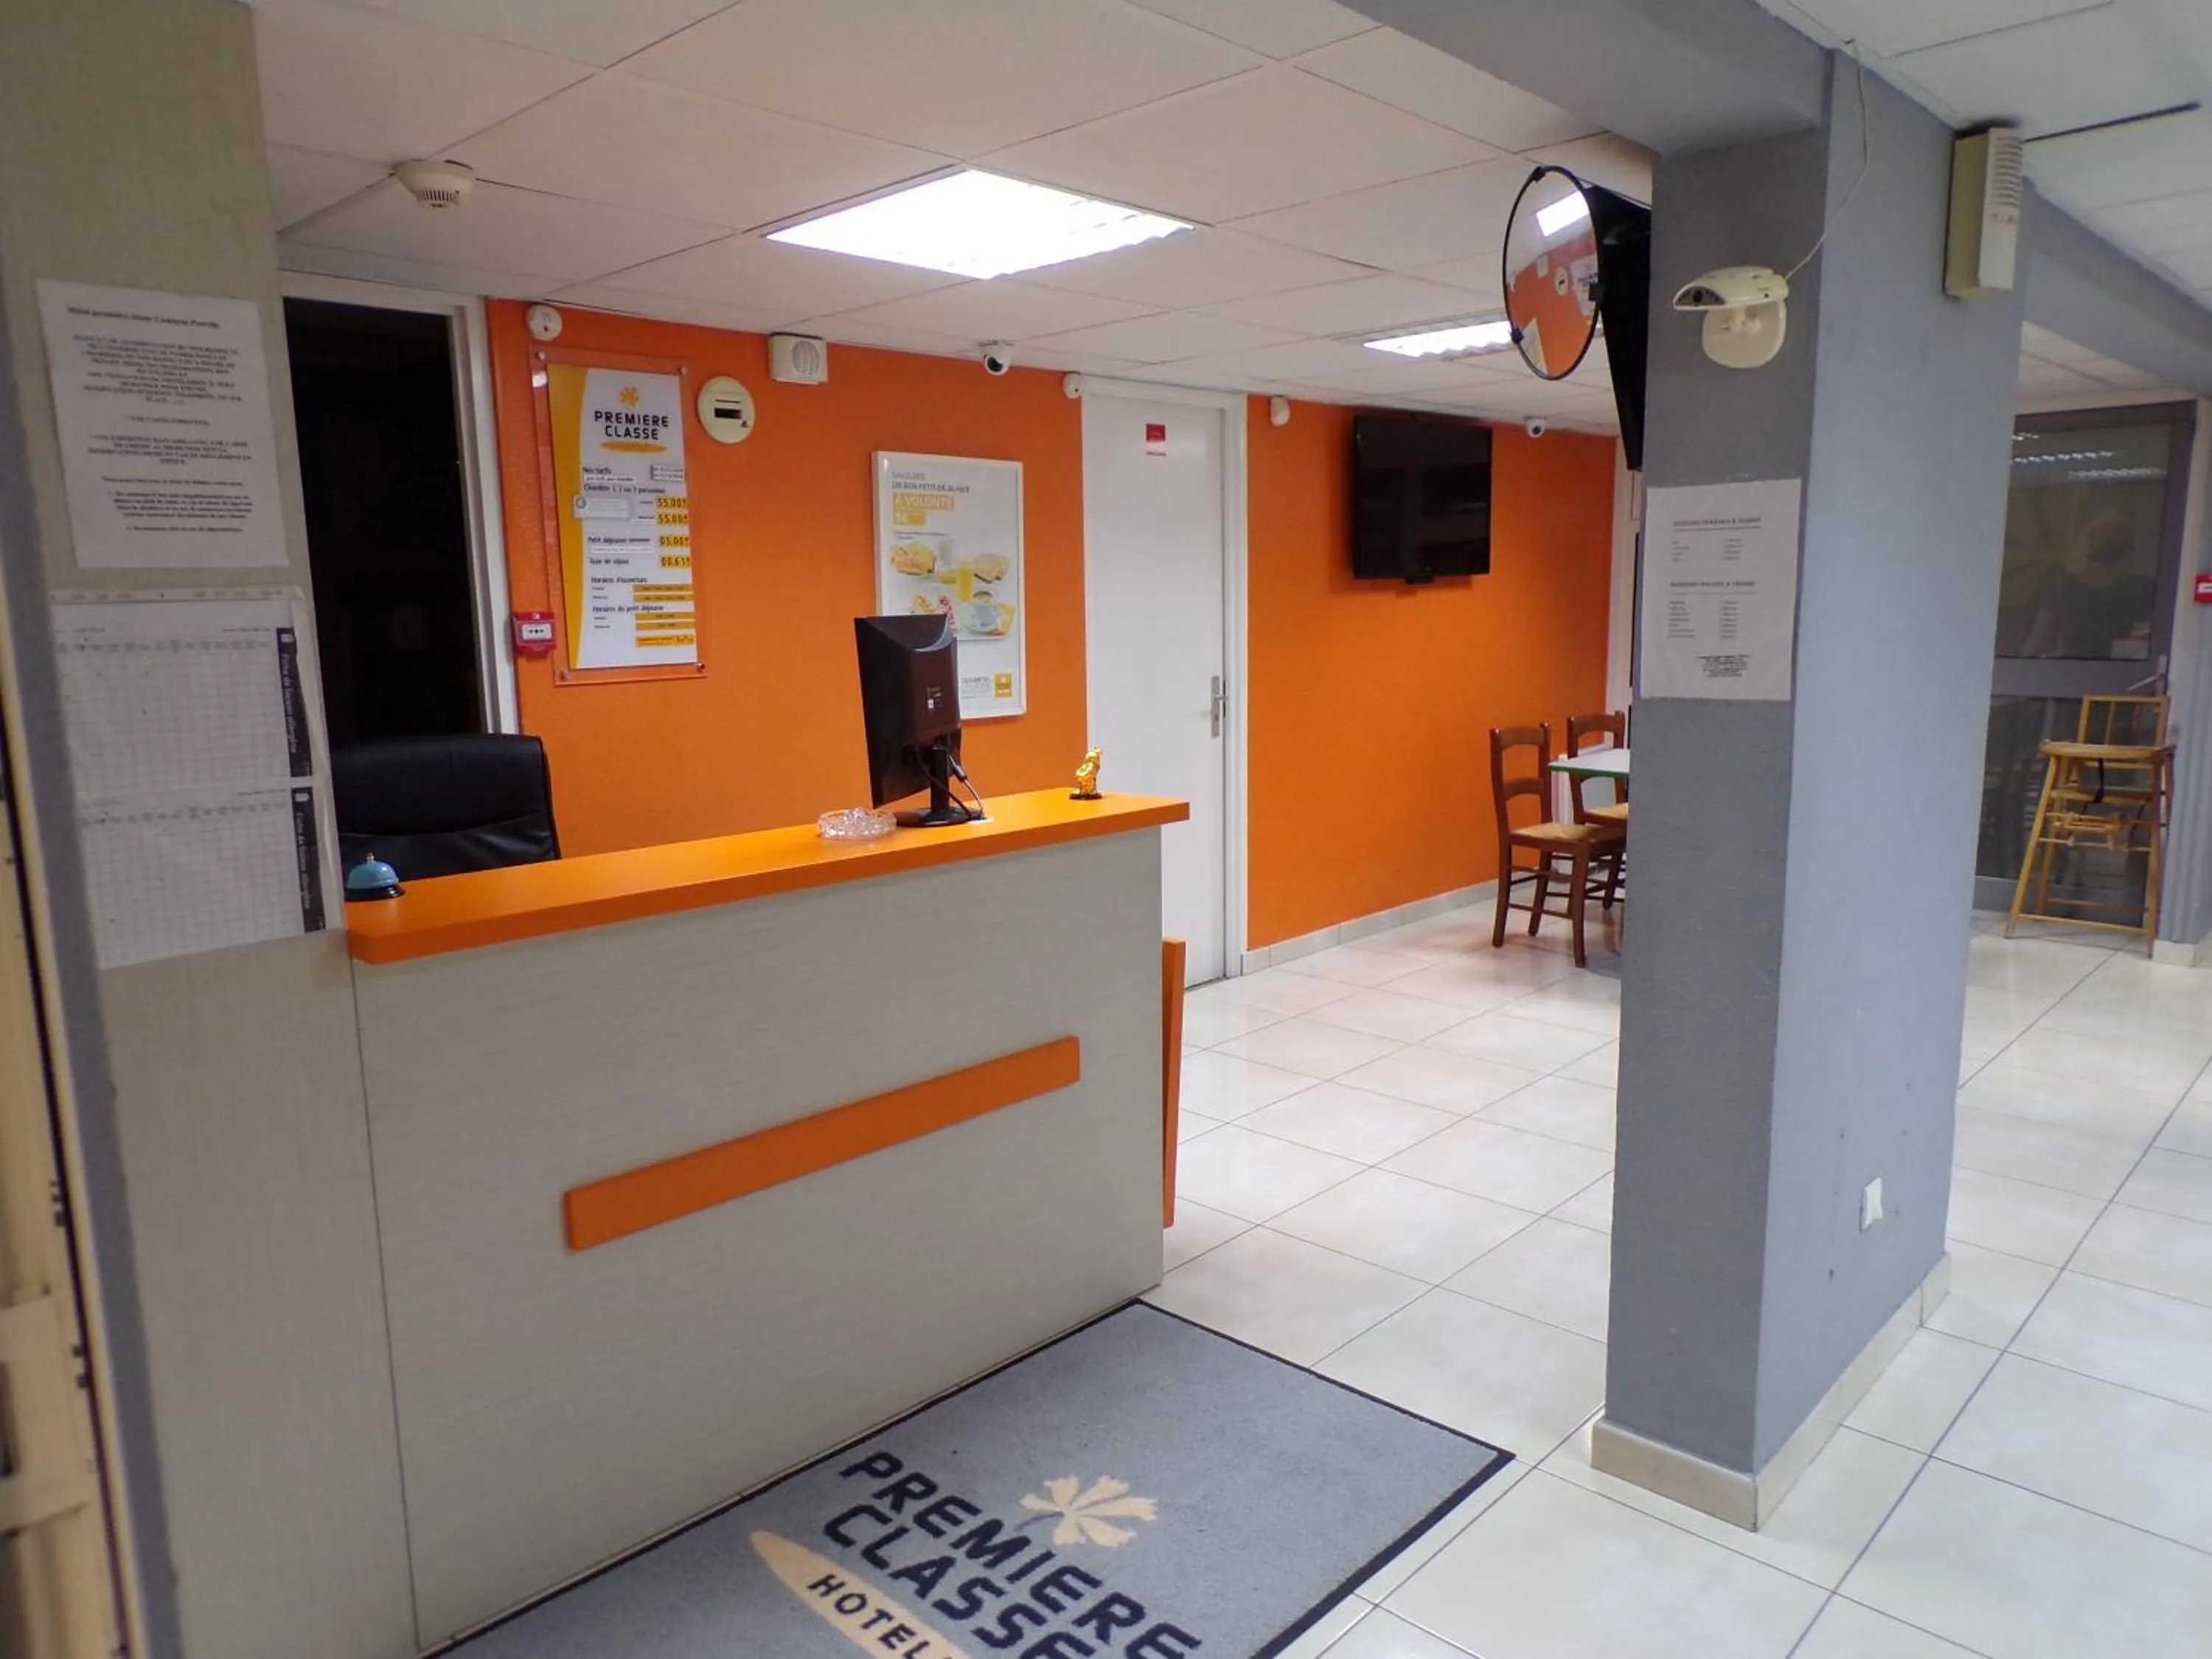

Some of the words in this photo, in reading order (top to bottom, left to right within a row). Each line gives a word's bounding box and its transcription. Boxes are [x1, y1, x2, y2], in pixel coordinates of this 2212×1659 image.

[594, 411, 669, 428] PREMIERE
[605, 425, 659, 440] CLASSE
[823, 1503, 1096, 1659] CLASSE
[839, 1450, 1203, 1659] PREMIERE
[807, 1573, 953, 1659] HOTEL
